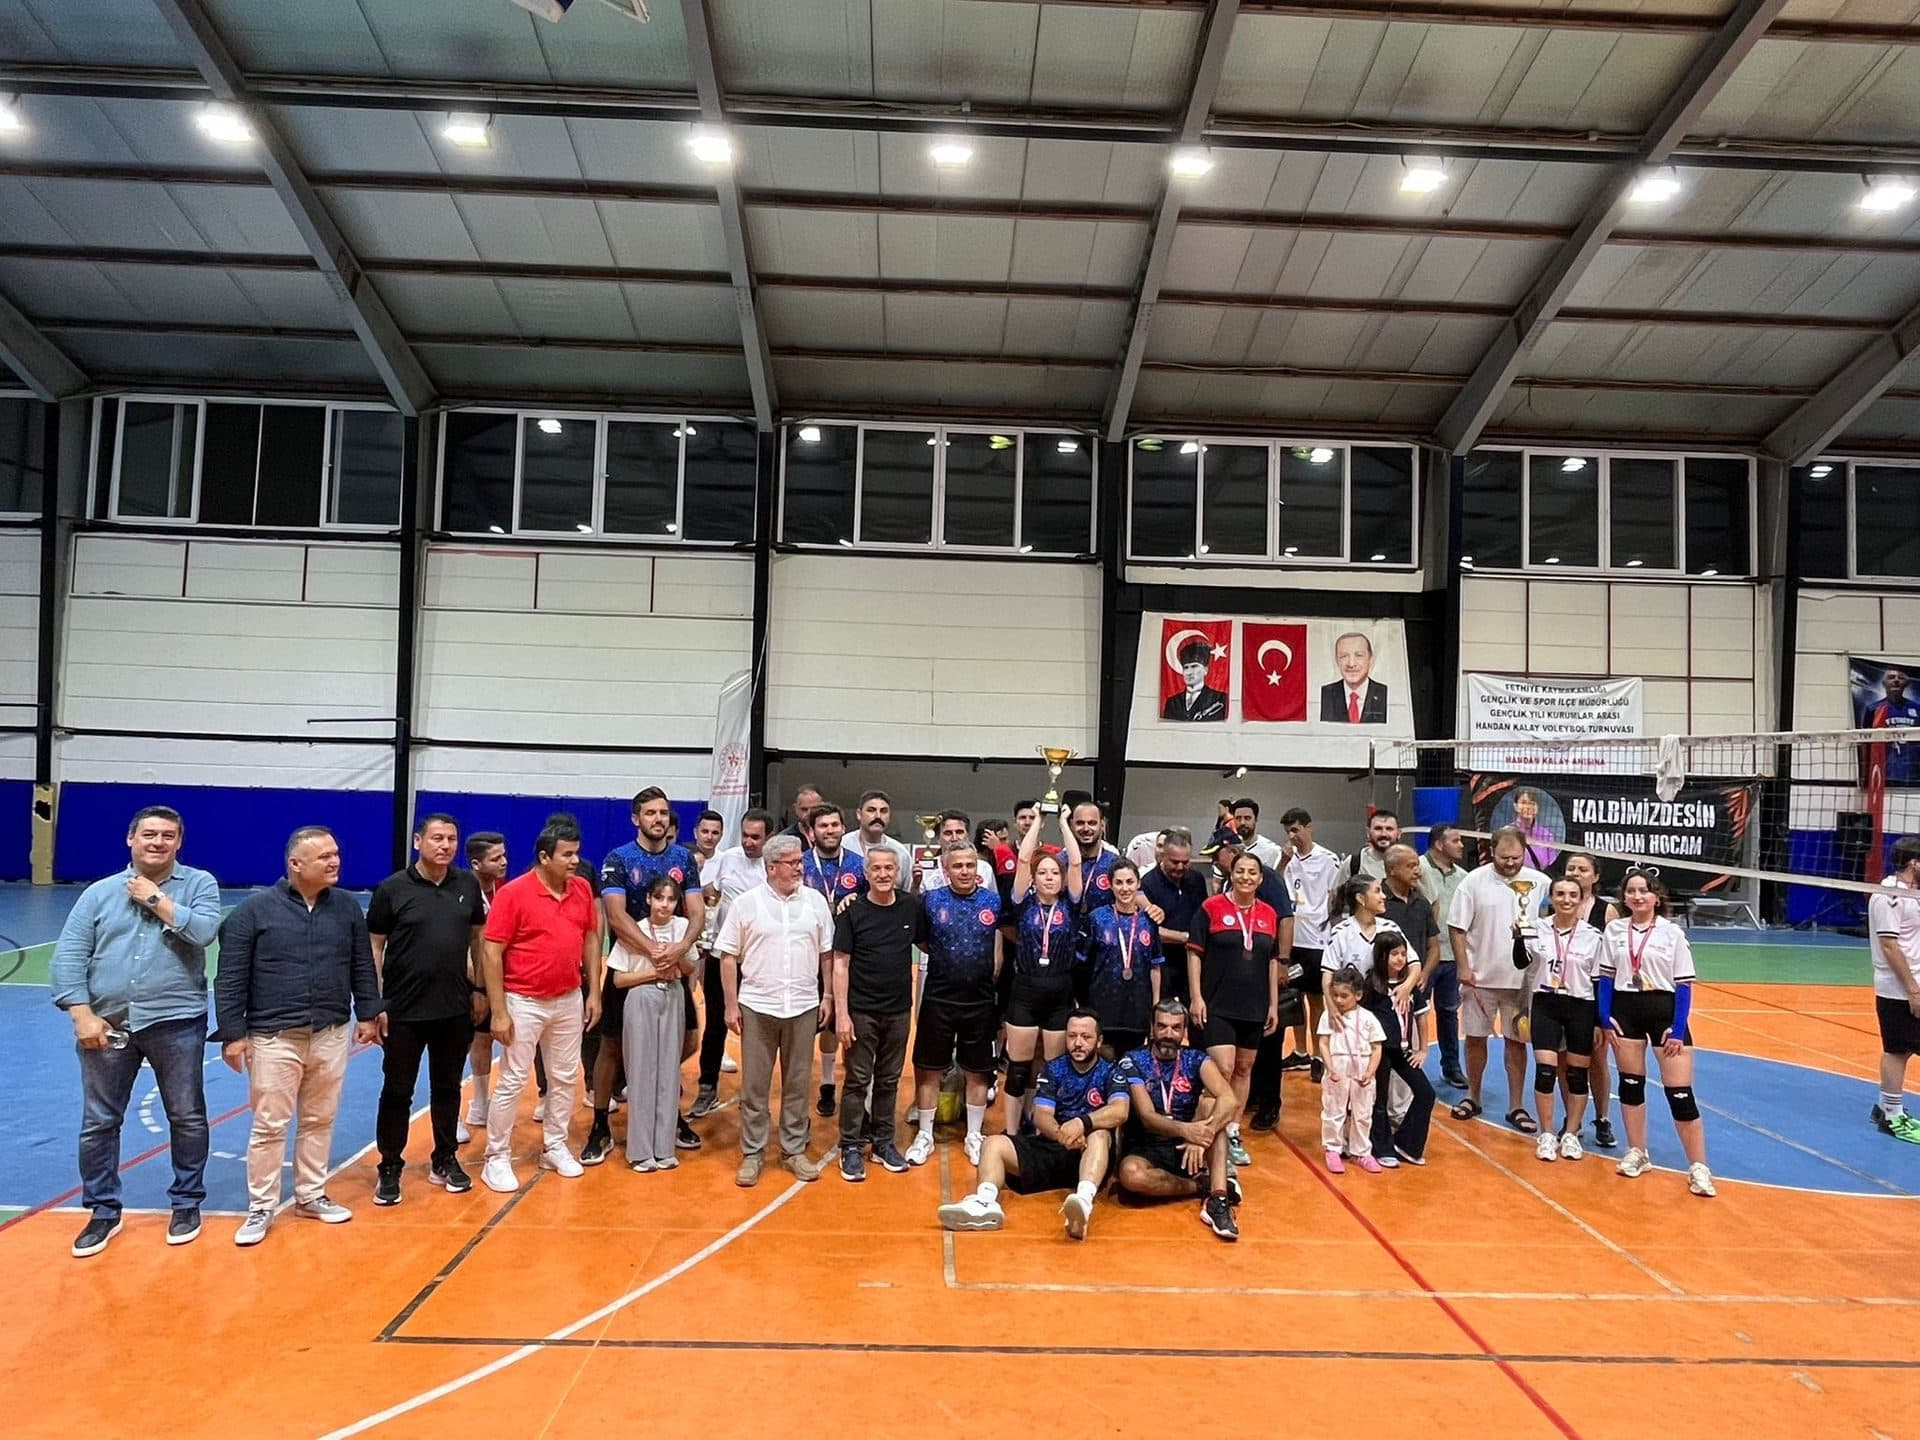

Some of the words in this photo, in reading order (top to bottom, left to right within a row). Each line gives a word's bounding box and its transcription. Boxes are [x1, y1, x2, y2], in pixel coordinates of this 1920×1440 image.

[1480, 694, 1517, 704] GENÇLİK
[1547, 711, 1594, 719] KURUMLAR
[1475, 722, 1511, 731] HANDAN
[1542, 724, 1586, 733] VOLEYBOL
[1588, 725, 1634, 733] TURNUVASI
[1572, 797, 1716, 828] KALBİMİZDESİN
[1584, 831, 1645, 854] HANDAN
[1649, 833, 1703, 855] HOCAM
[1294, 878, 1301, 890] 6
[1547, 959, 1563, 974] 15
